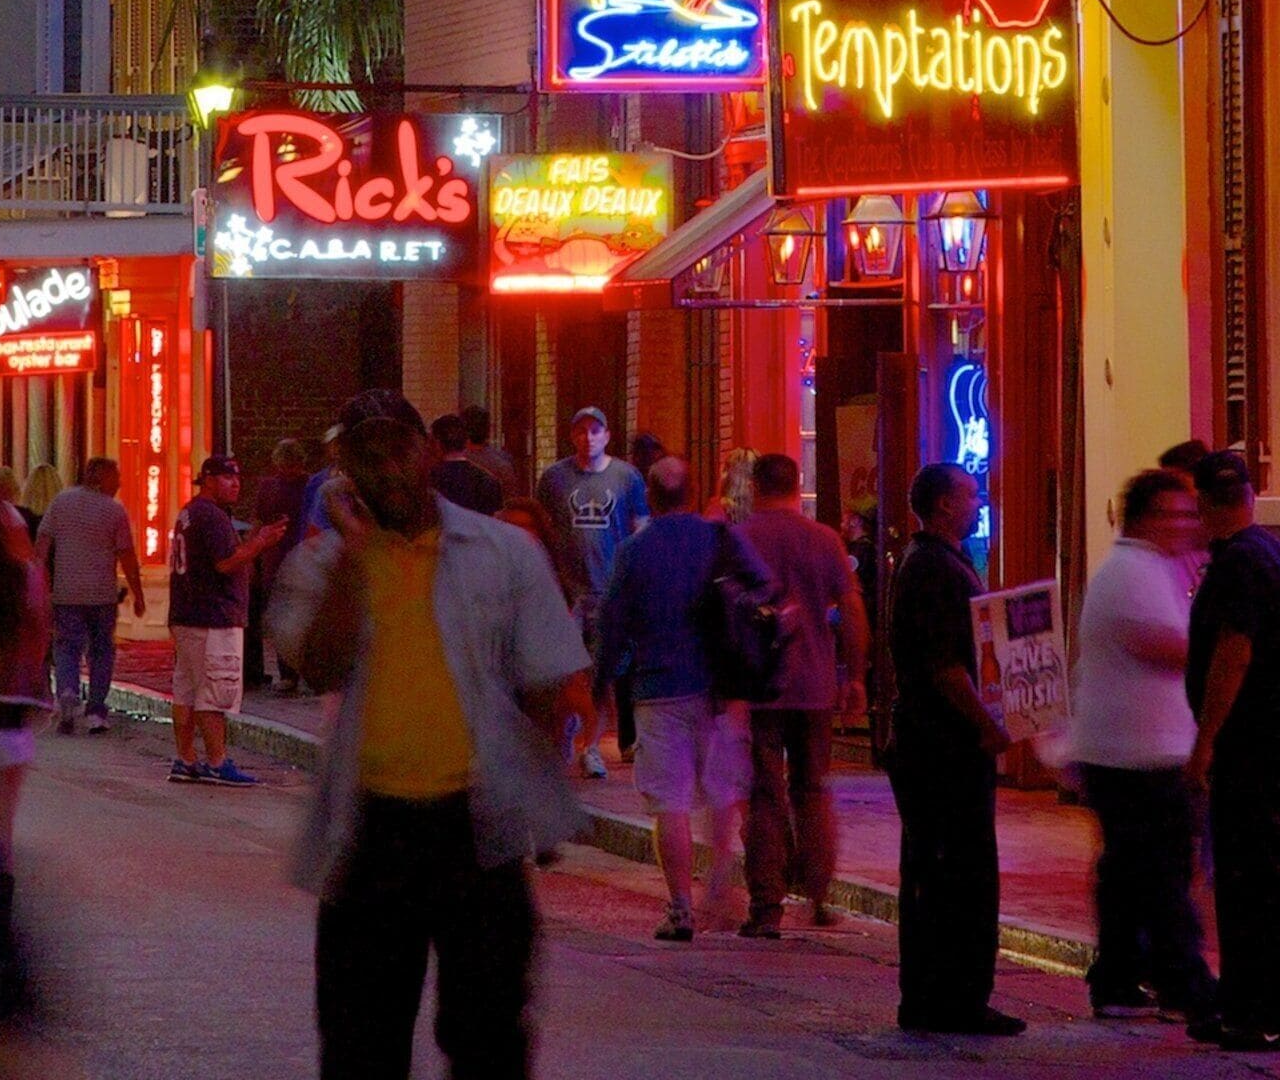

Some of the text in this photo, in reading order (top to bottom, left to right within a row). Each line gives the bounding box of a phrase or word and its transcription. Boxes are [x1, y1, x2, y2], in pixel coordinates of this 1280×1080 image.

[790, 0, 1068, 119] Temptations
[237, 113, 472, 224] Rick's
[551, 157, 610, 184] FAIS
[269, 239, 444, 262] CABARET
[1005, 683, 1061, 714] MUSIC
